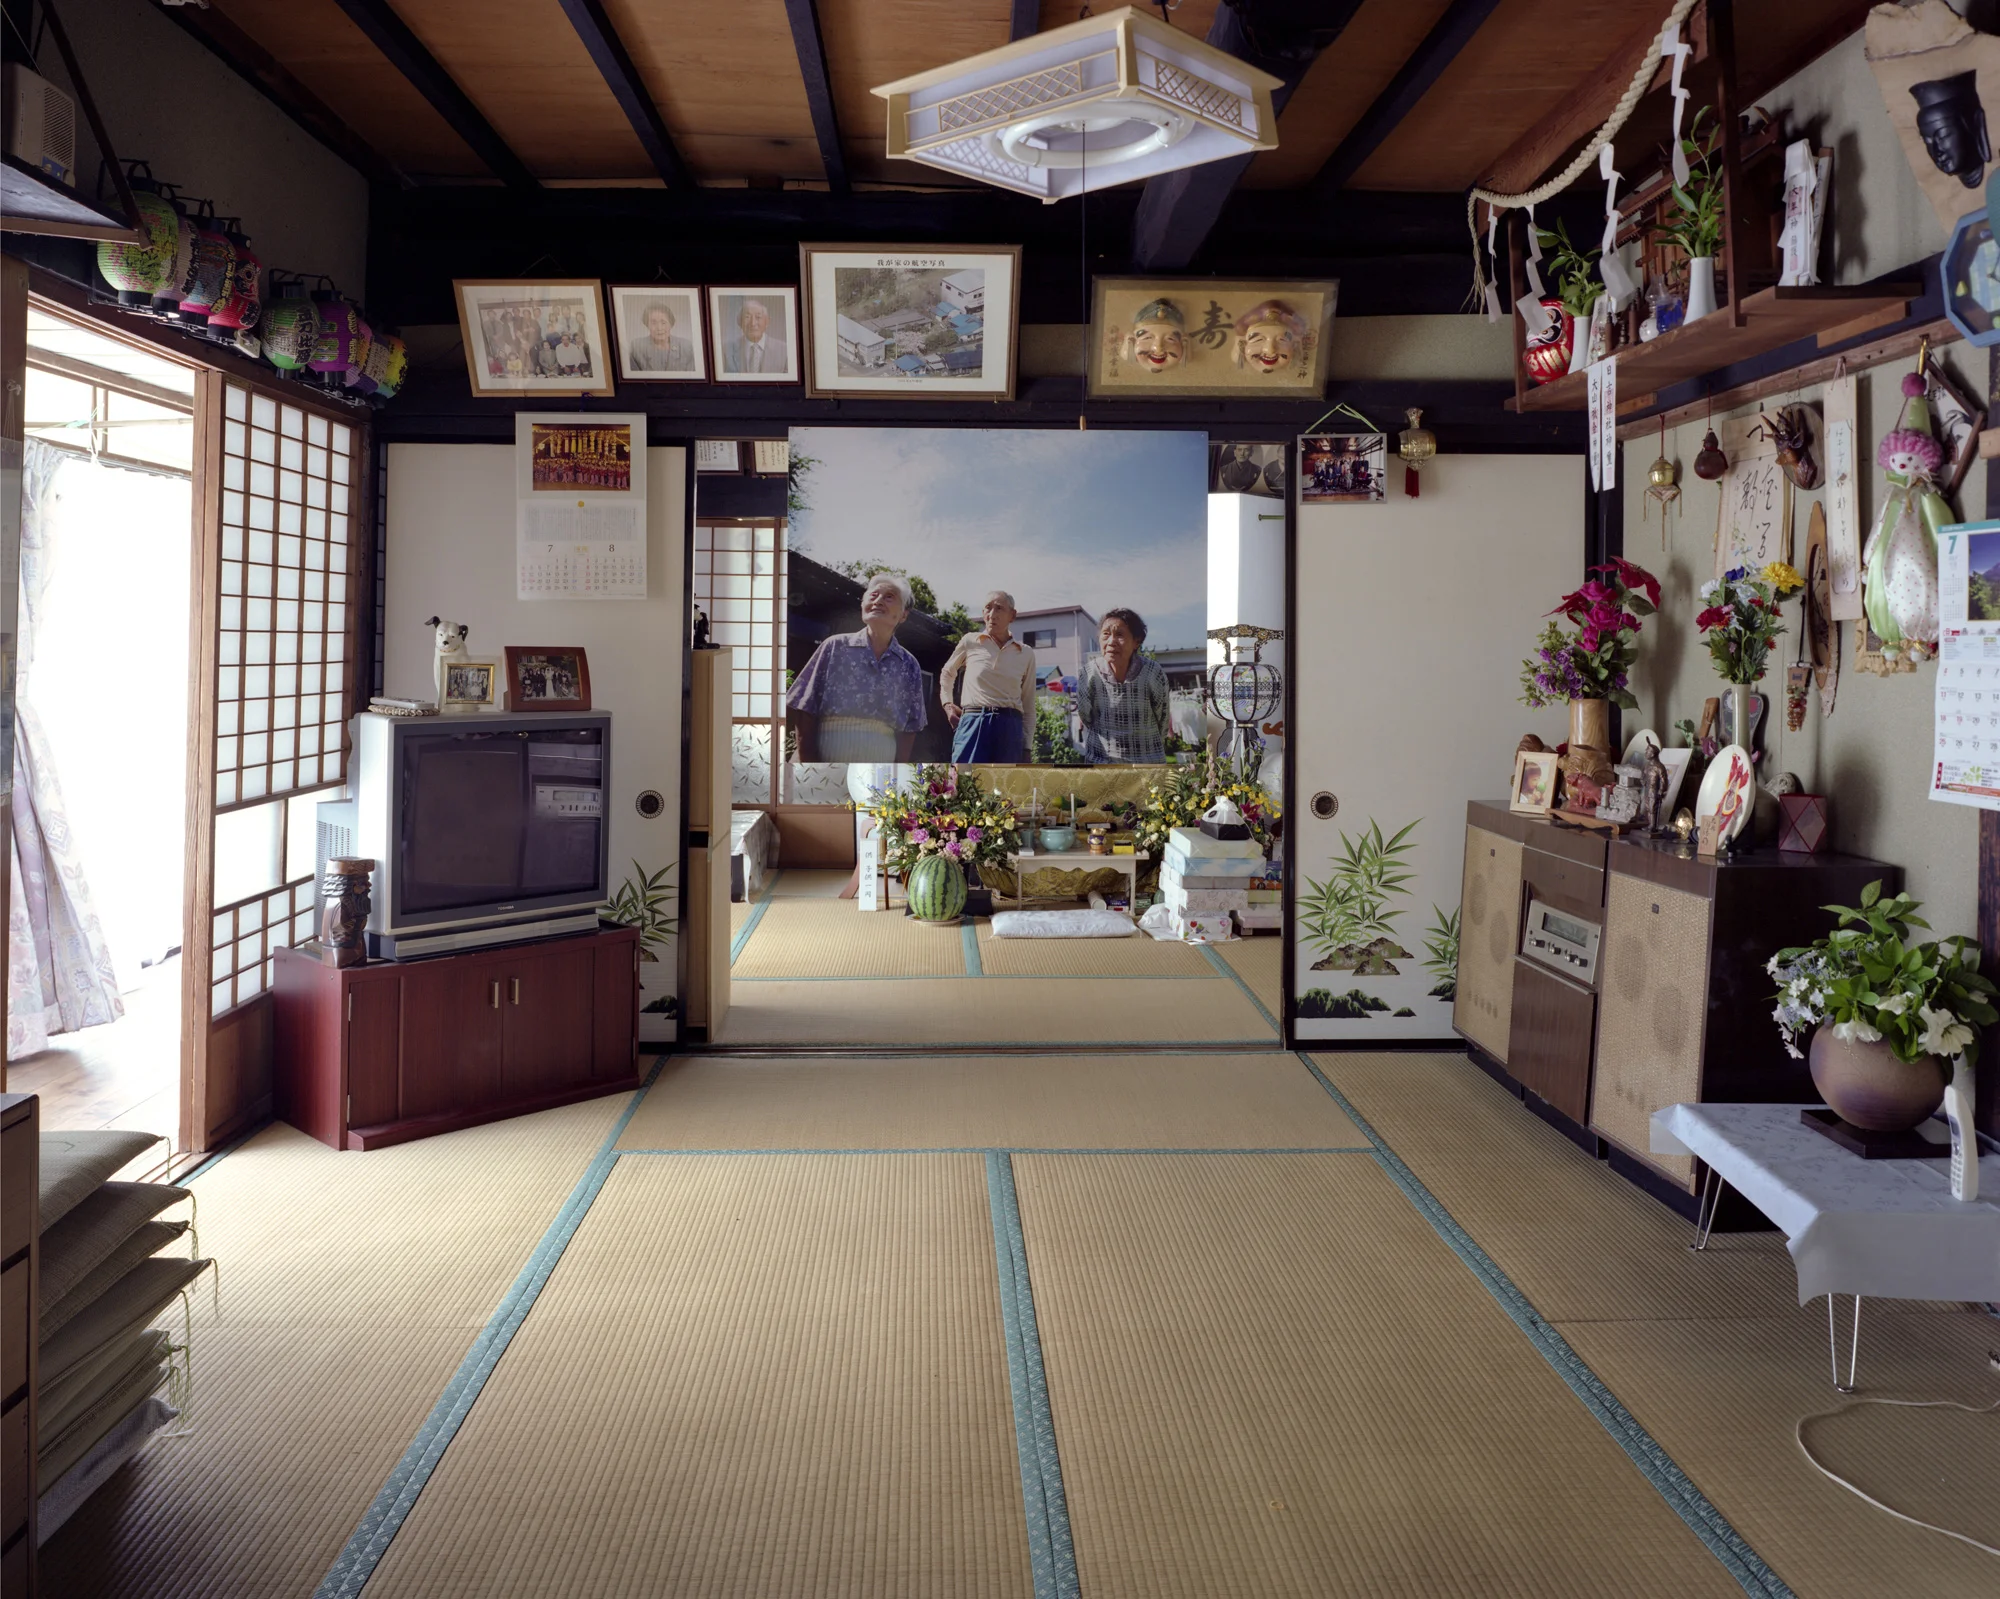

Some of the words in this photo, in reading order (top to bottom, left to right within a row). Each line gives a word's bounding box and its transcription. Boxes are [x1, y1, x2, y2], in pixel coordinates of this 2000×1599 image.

[877, 259, 945, 267] 我が家の航空写真
[1189, 300, 1236, 350] 寿
[609, 544, 615, 552] 8
[1948, 535, 1958, 554] 7
